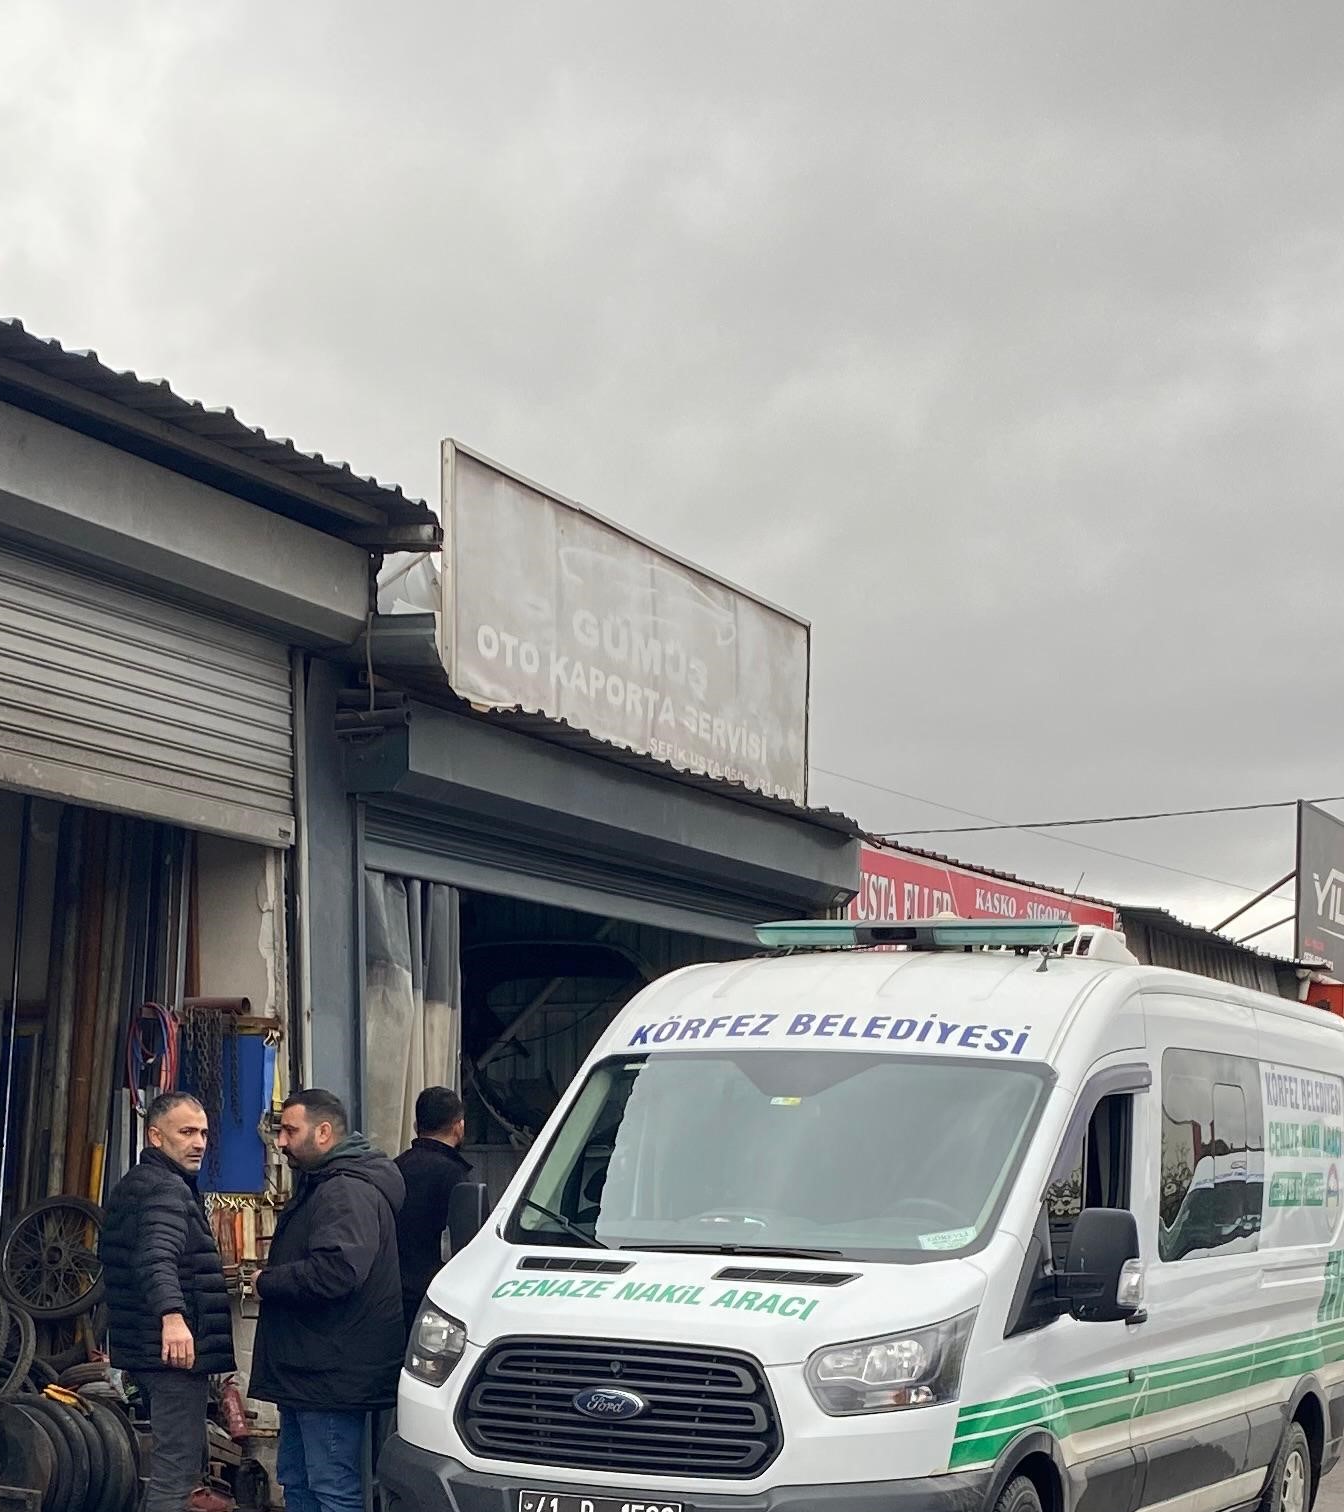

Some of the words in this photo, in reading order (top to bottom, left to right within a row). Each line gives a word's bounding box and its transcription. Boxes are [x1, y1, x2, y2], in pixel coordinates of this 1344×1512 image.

[477, 624, 540, 673] OTO
[549, 651, 676, 728] KAPORTA
[683, 705, 768, 765] SERVİSİ
[856, 871, 898, 920] USTA
[975, 888, 1017, 918] KASKO
[628, 1013, 779, 1047] KÖRFEZ
[785, 1013, 1033, 1055] BELEDİYESİ
[1265, 1065, 1300, 1110] KÖRFEZ
[492, 1279, 615, 1300] CENAZE
[613, 1281, 706, 1306] NAKİL
[710, 1289, 820, 1321] ARACI
[587, 1393, 626, 1413] Ford
